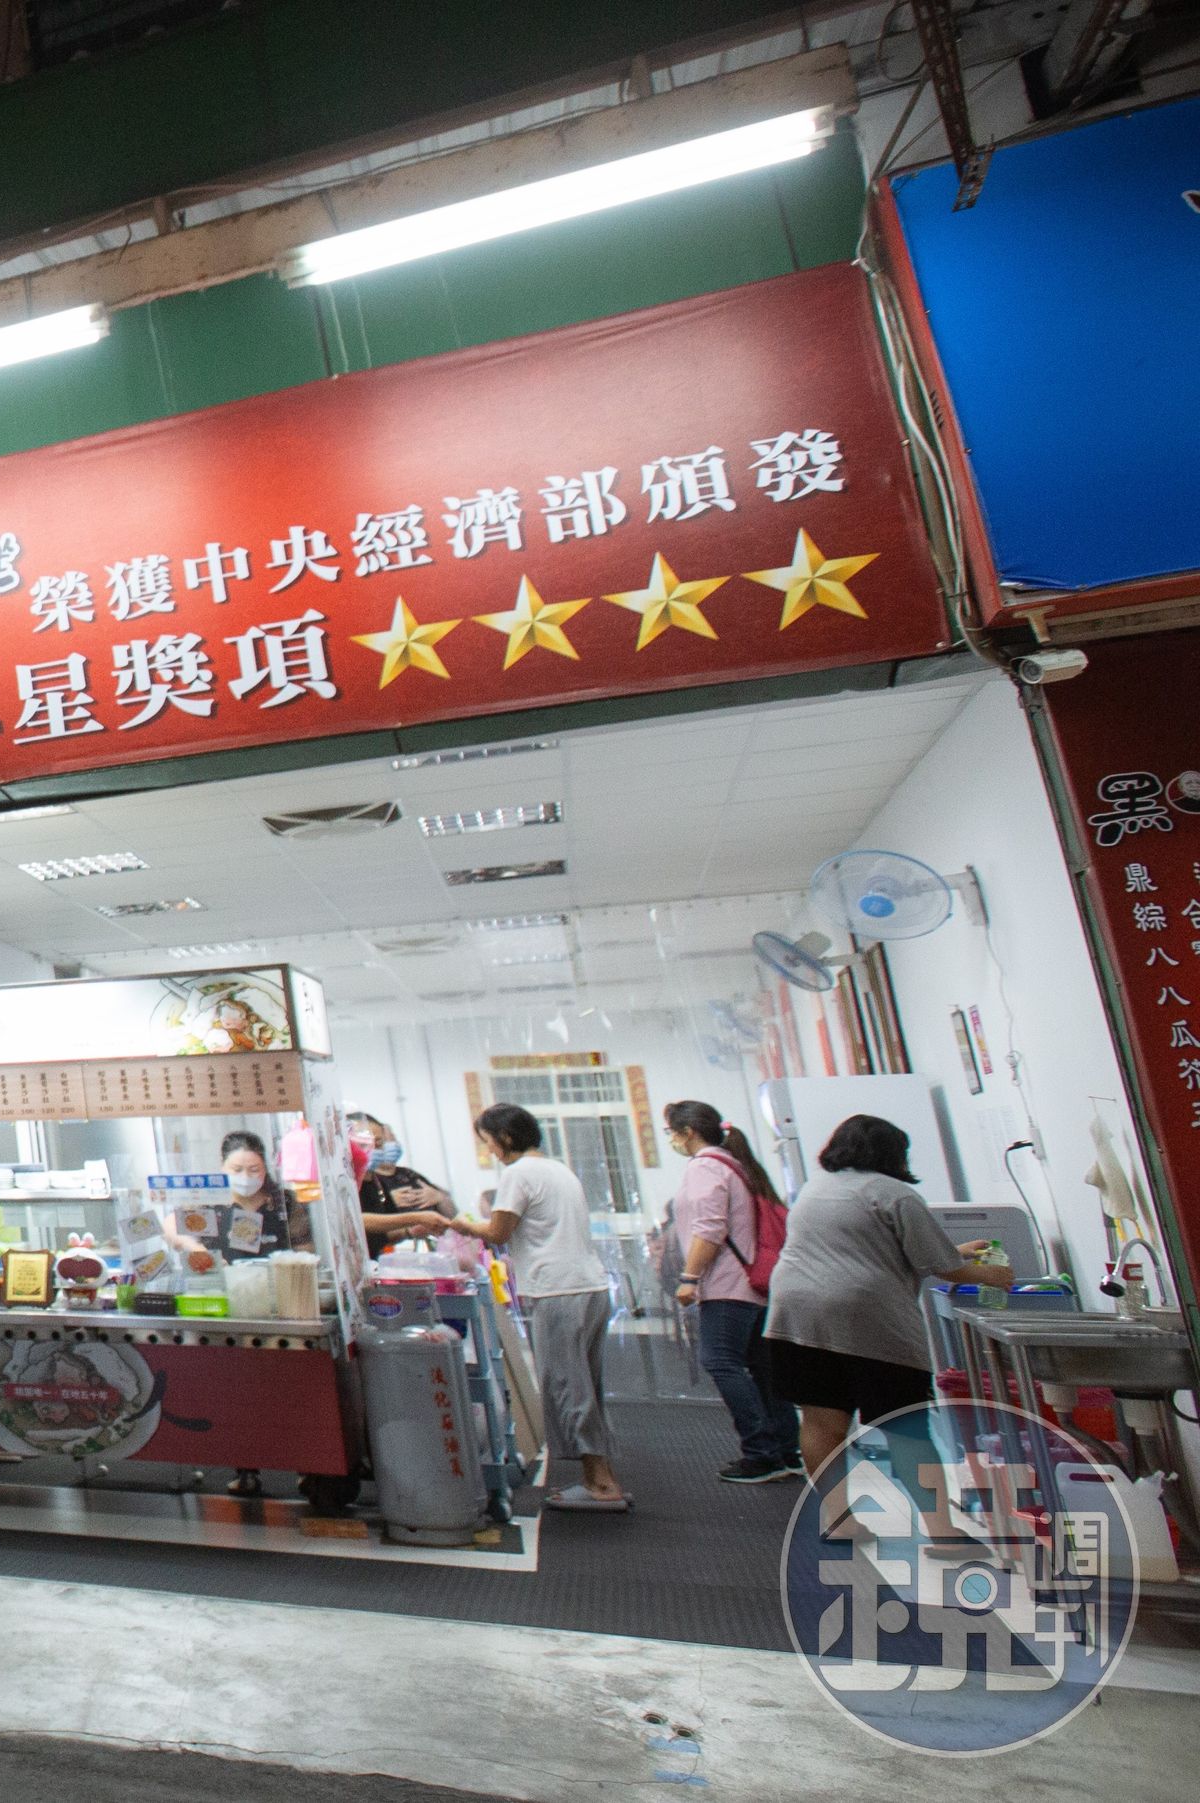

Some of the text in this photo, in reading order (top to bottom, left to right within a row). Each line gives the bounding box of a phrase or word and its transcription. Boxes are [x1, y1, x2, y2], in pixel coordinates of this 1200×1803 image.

[30, 429, 845, 632] 榮獲中央經濟部頒發
